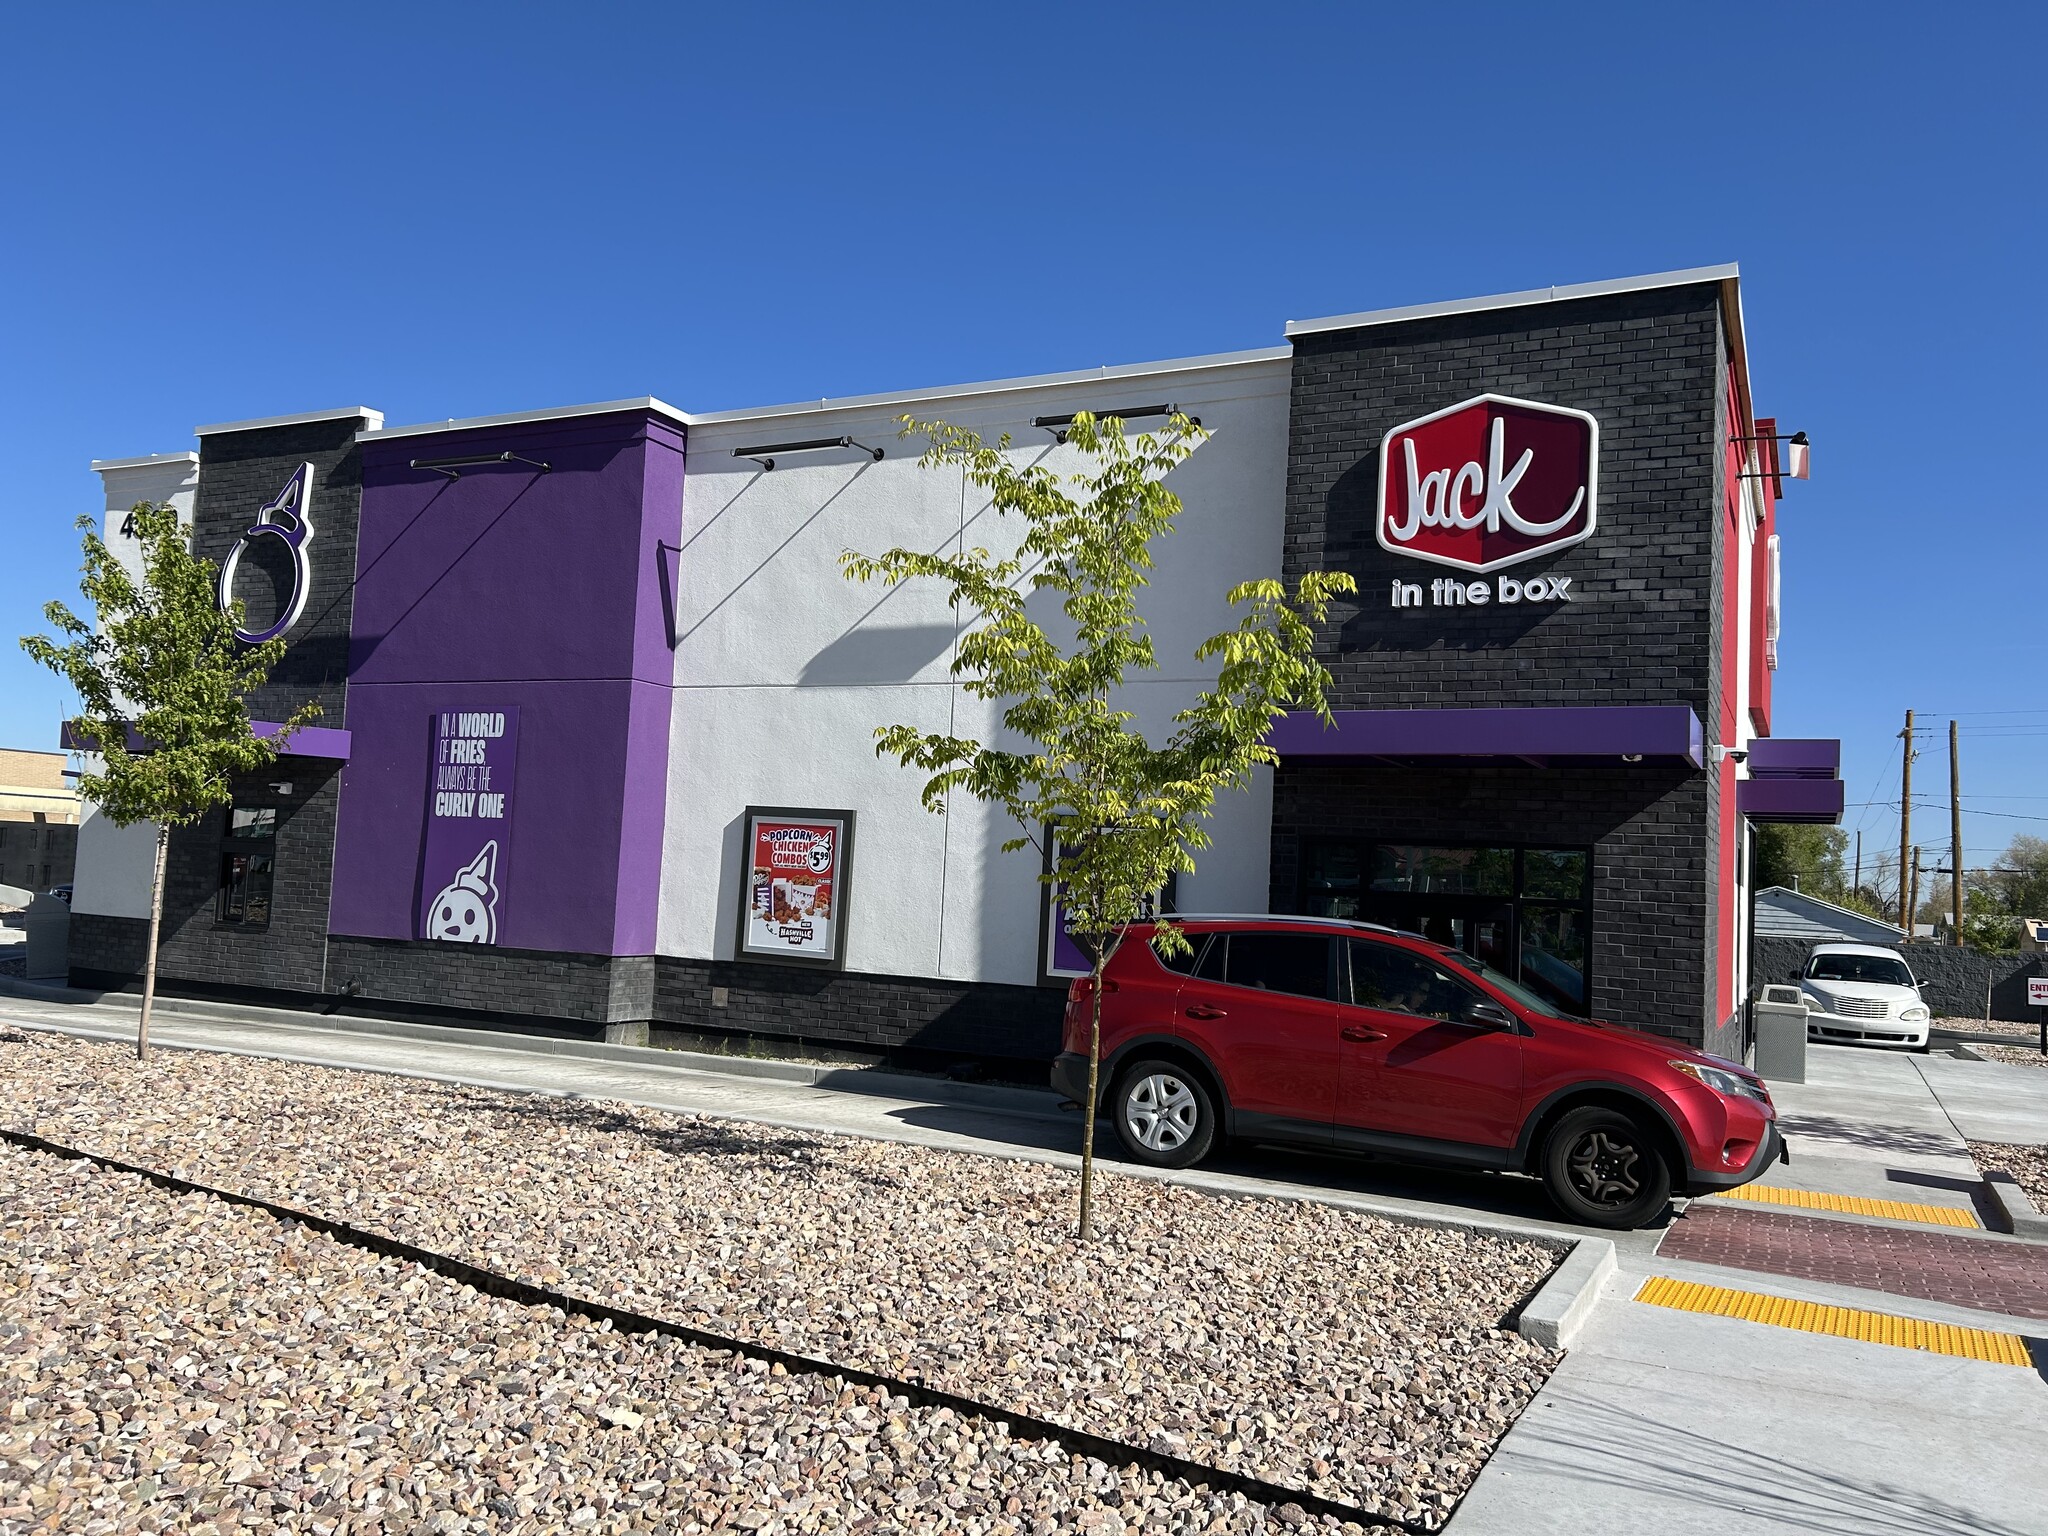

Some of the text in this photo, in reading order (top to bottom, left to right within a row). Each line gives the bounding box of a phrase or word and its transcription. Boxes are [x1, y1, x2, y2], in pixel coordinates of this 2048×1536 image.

[1387, 416, 1585, 541] Jack
[1391, 575, 1573, 608] in the box
[441, 712, 505, 737] IN A WORLD
[439, 739, 487, 766] OF FRIES,
[437, 765, 492, 791] ALWAYS BE THE
[435, 792, 505, 819] CURLY ONE
[770, 829, 813, 842] POPCORN
[773, 840, 809, 853] CHICKEN
[772, 852, 808, 866] COMBOS
[780, 927, 812, 938] NASHVILLE
[2030, 983, 2048, 992] ENT
